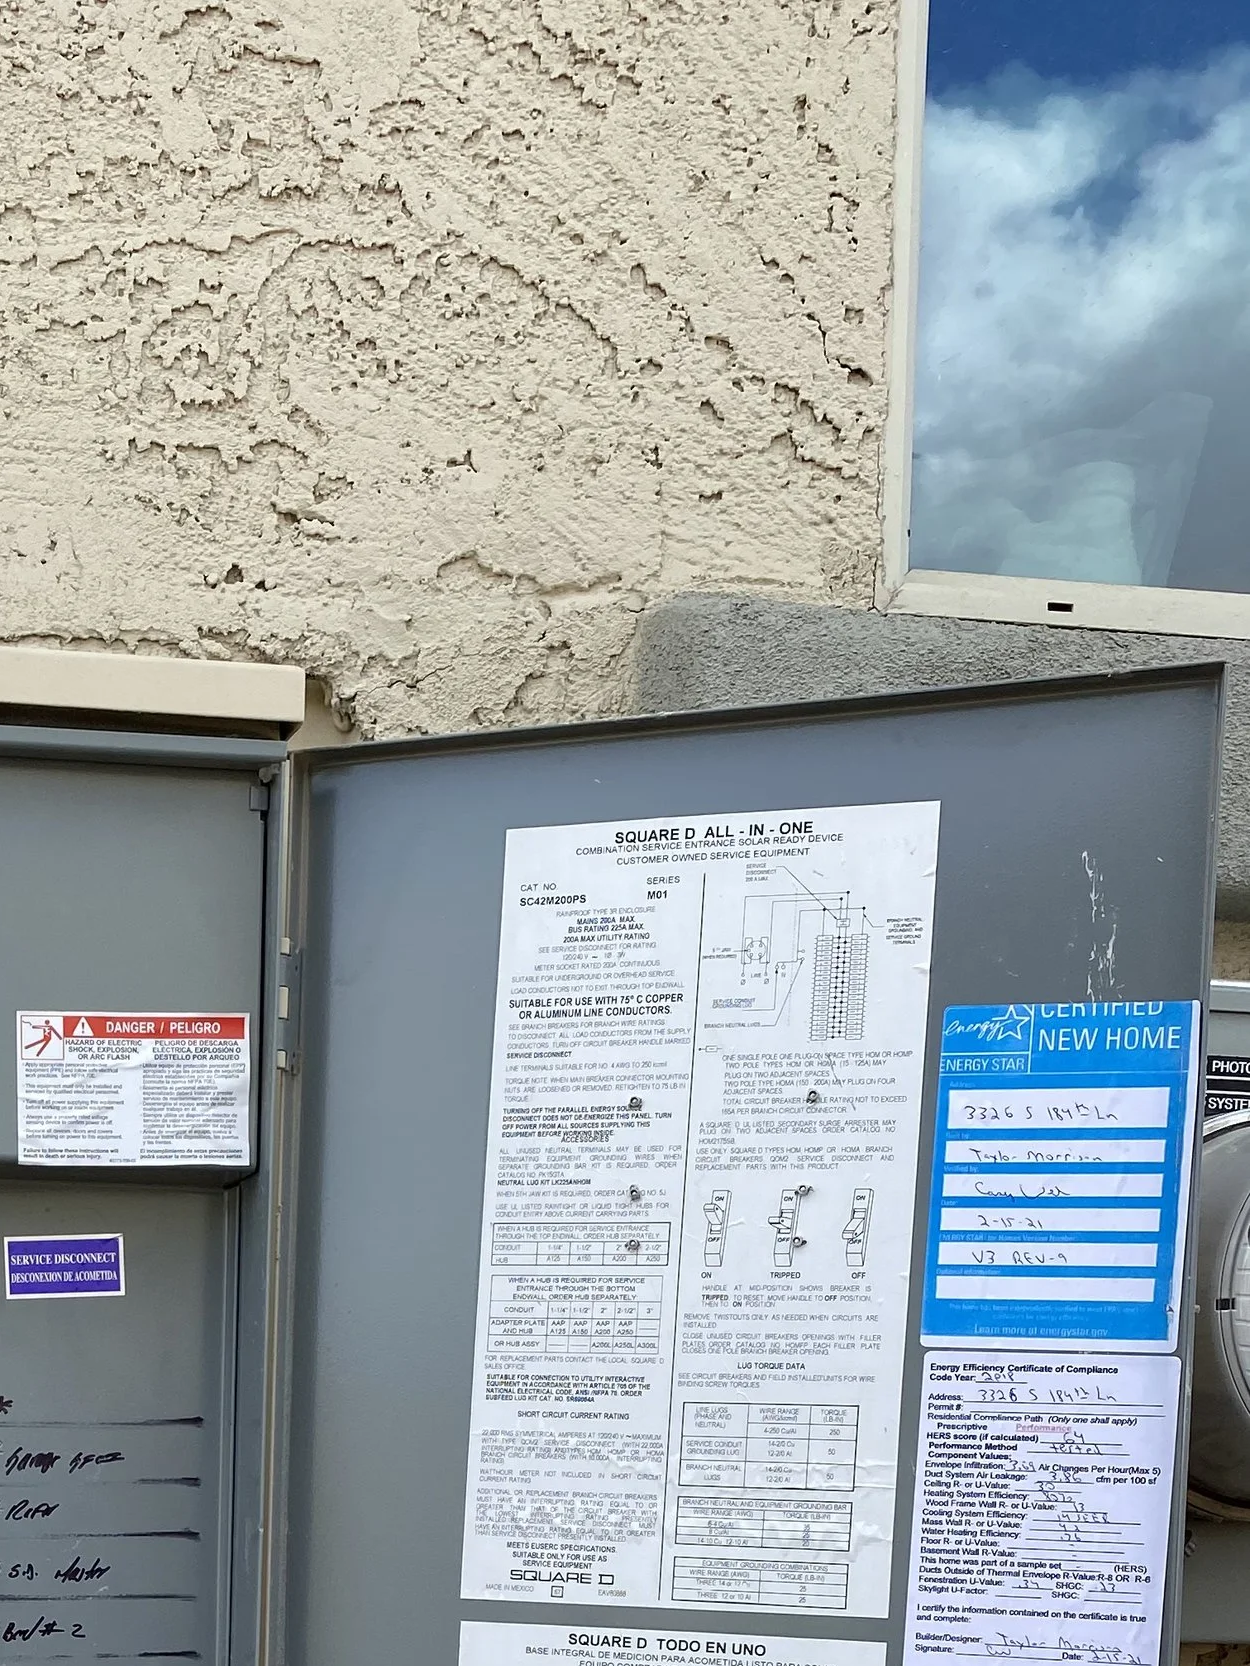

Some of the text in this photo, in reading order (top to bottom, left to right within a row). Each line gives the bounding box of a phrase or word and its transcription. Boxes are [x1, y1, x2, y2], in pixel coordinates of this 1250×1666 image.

[615, 828, 680, 845] SQUARE
[684, 828, 696, 840] D
[705, 825, 734, 839] ALL
[748, 824, 766, 837] IN
[780, 822, 813, 835] ONE
[576, 833, 843, 856] COMBINATION SERVICE ENTRANCE SOLAR READY DEVICE
[647, 876, 680, 885] SERIES
[520, 890, 668, 907] SC42M200PS M01
[106, 1022, 155, 1033] DANGER
[170, 1022, 220, 1033] PELIGRO
[1039, 1027, 1181, 1051] NEW HOME
[941, 1058, 1025, 1071] ENERGY STAR
[11, 1252, 116, 1266] SERVICE DISCONNECT
[63, 1271, 73, 1282] DE
[74, 1271, 117, 1282] ACOMETIDA
[930, 1364, 1118, 1376] Energy Efficiency Certificate of Compliance
[510, 1569, 614, 1586] SQUARE D
[568, 1633, 766, 1656] SQUARE D TODO EN UNO
